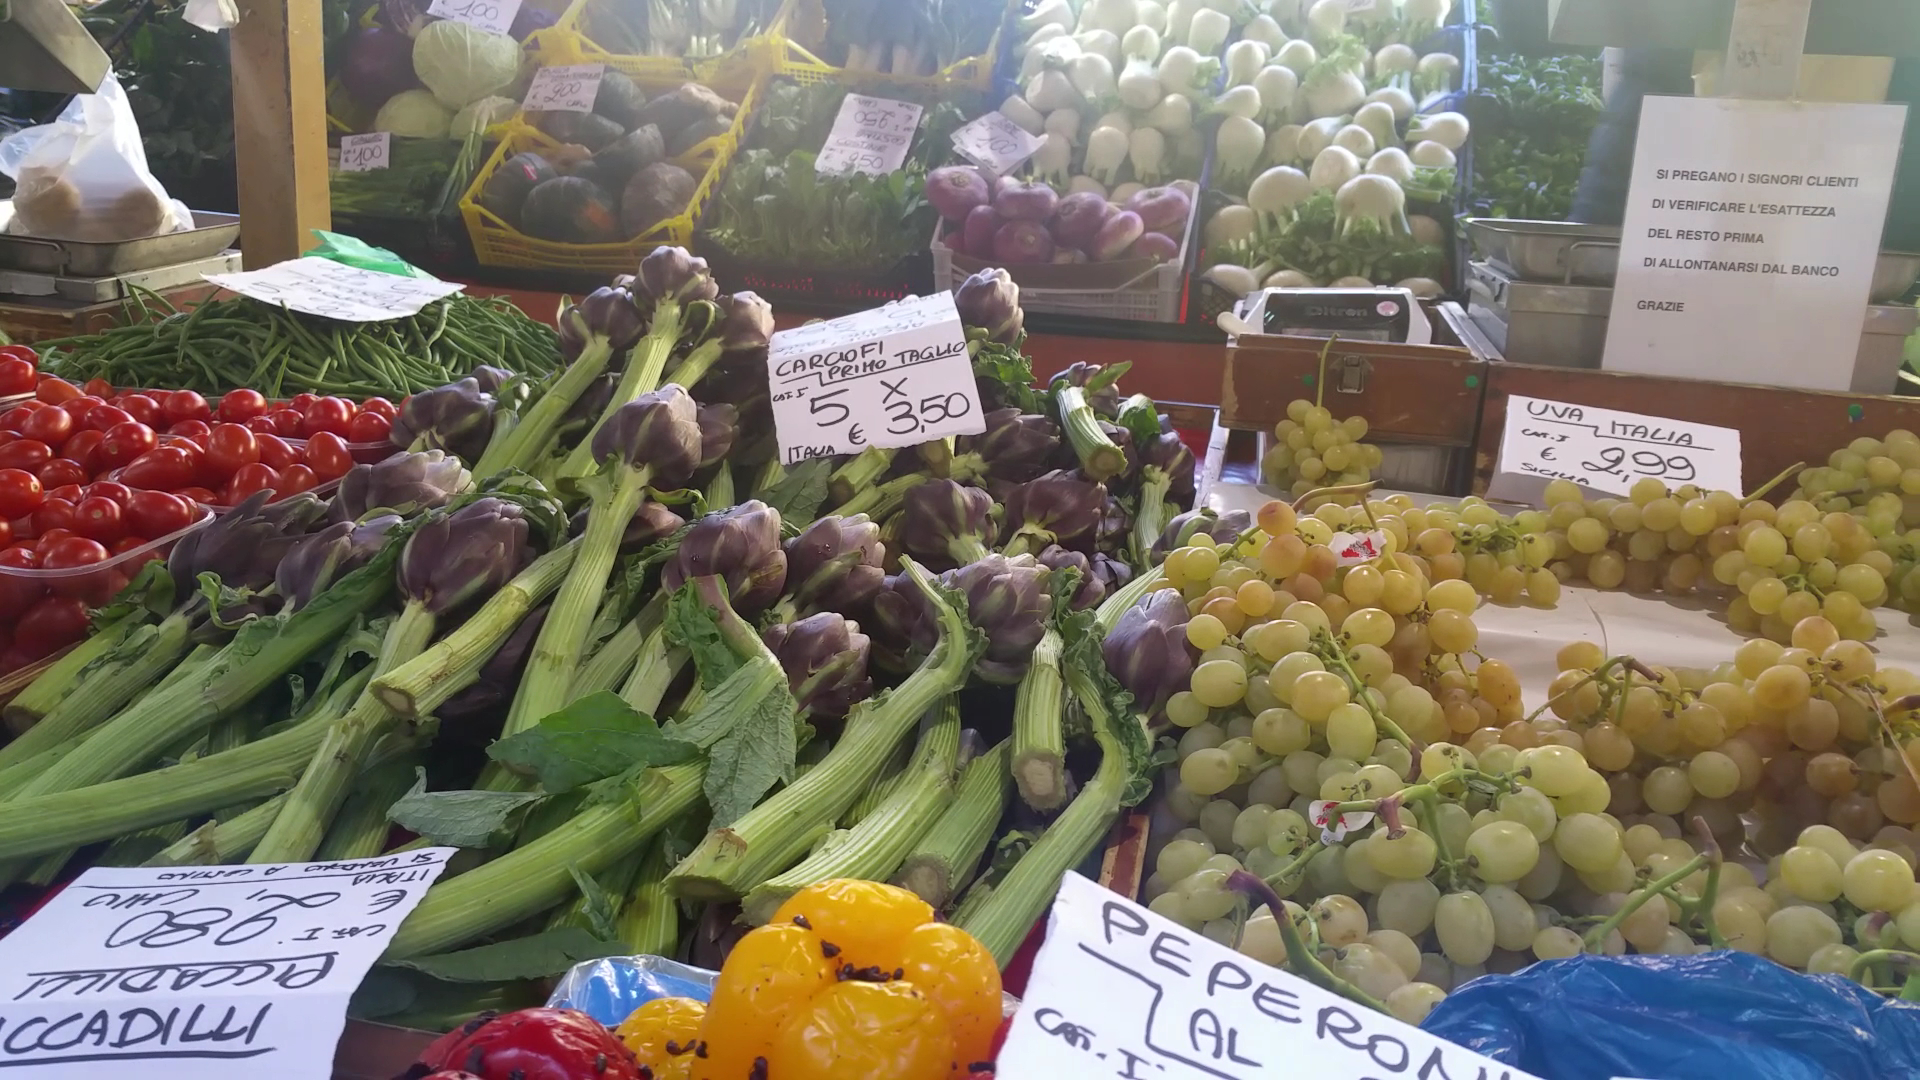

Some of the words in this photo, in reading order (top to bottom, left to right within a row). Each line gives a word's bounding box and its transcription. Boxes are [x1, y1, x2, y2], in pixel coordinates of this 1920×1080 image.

[1656, 168, 1669, 180] SI
[1672, 170, 1737, 183] PREGANO
[1740, 173, 1744, 183] I
[1747, 173, 1803, 186] SIGNORI
[1806, 175, 1859, 188] CLIENTI
[1652, 198, 1664, 209] DI
[1669, 199, 1745, 213] VERIFICARE
[1749, 203, 1836, 217] L'ESATTEZZA
[1647, 228, 1672, 239] DEL
[1676, 229, 1720, 242] RESTO
[1723, 232, 1764, 244] PRIMA
[1643, 257, 1656, 268] DI
[1659, 258, 1758, 273] ALLONTANARSI
[1761, 263, 1788, 275] DAL
[1791, 265, 1839, 277] BANCO
[1637, 300, 1685, 312] GRAZIE
[828, 359, 887, 380] PRIMO
[893, 341, 966, 365] TAGLIO
[810, 388, 850, 427] 5
[848, 423, 867, 445] €
[885, 392, 970, 434] 3,50
[1526, 401, 1584, 421] UVA
[1611, 420, 1693, 445] ITALIA
[1540, 447, 1557, 461] €
[1581, 447, 1696, 483] 2,99
[368, 888, 408, 916] €
[13, 953, 337, 1001] PICCADILLI
[1102, 901, 1510, 1080] PEPERON
[0, 1002, 273, 1055] CCADILLI
[1190, 1008, 1263, 1068] AL
